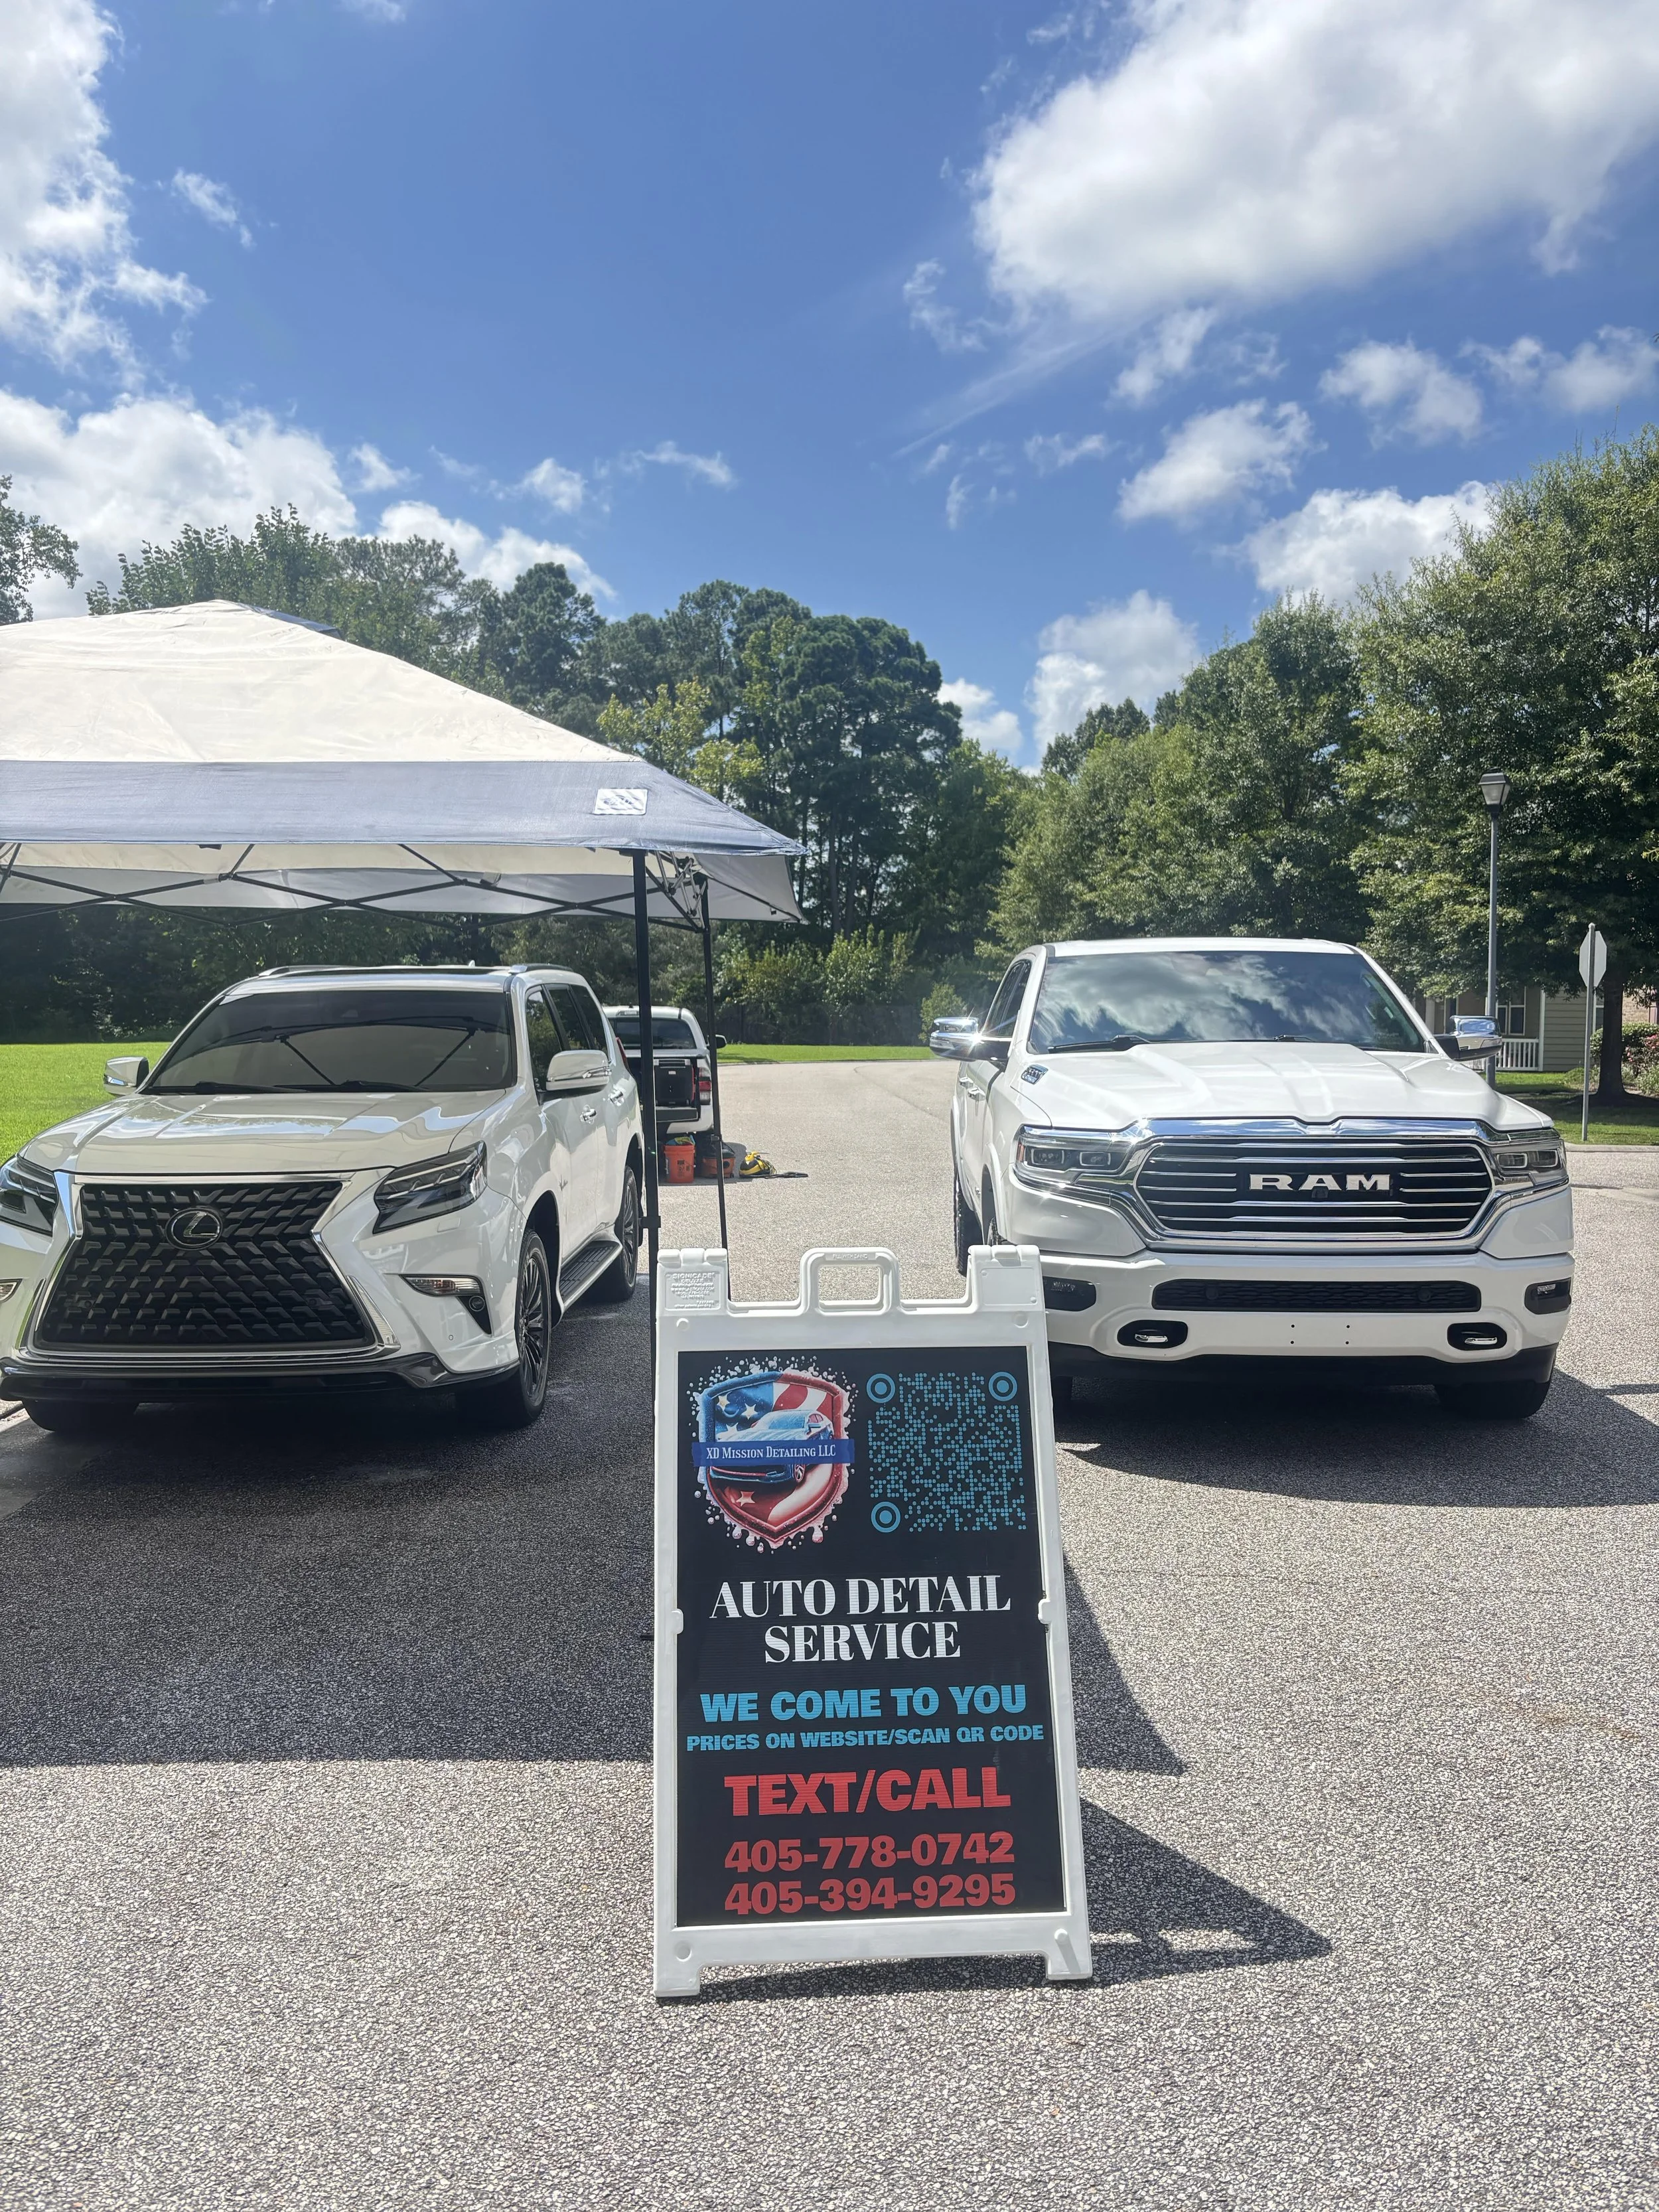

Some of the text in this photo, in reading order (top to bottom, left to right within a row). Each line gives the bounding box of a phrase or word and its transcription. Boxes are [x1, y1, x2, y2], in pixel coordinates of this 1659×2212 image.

[1250, 1174, 1390, 1191] RAM
[706, 1444, 836, 1459] XD MISSION DETAILING LLC
[709, 1576, 1011, 1619] AUTO DETAIL
[765, 1621, 961, 1663] SERVICE
[700, 1684, 1027, 1722] WE COME TO YOU
[687, 1725, 1044, 1751] PRICES ON WEBSITE/SCAN QR CODE
[724, 1767, 1011, 1816] TEXT/CALL
[725, 1832, 1015, 1872] 405-778-0742
[725, 1874, 1015, 1915] 405-394-9295
